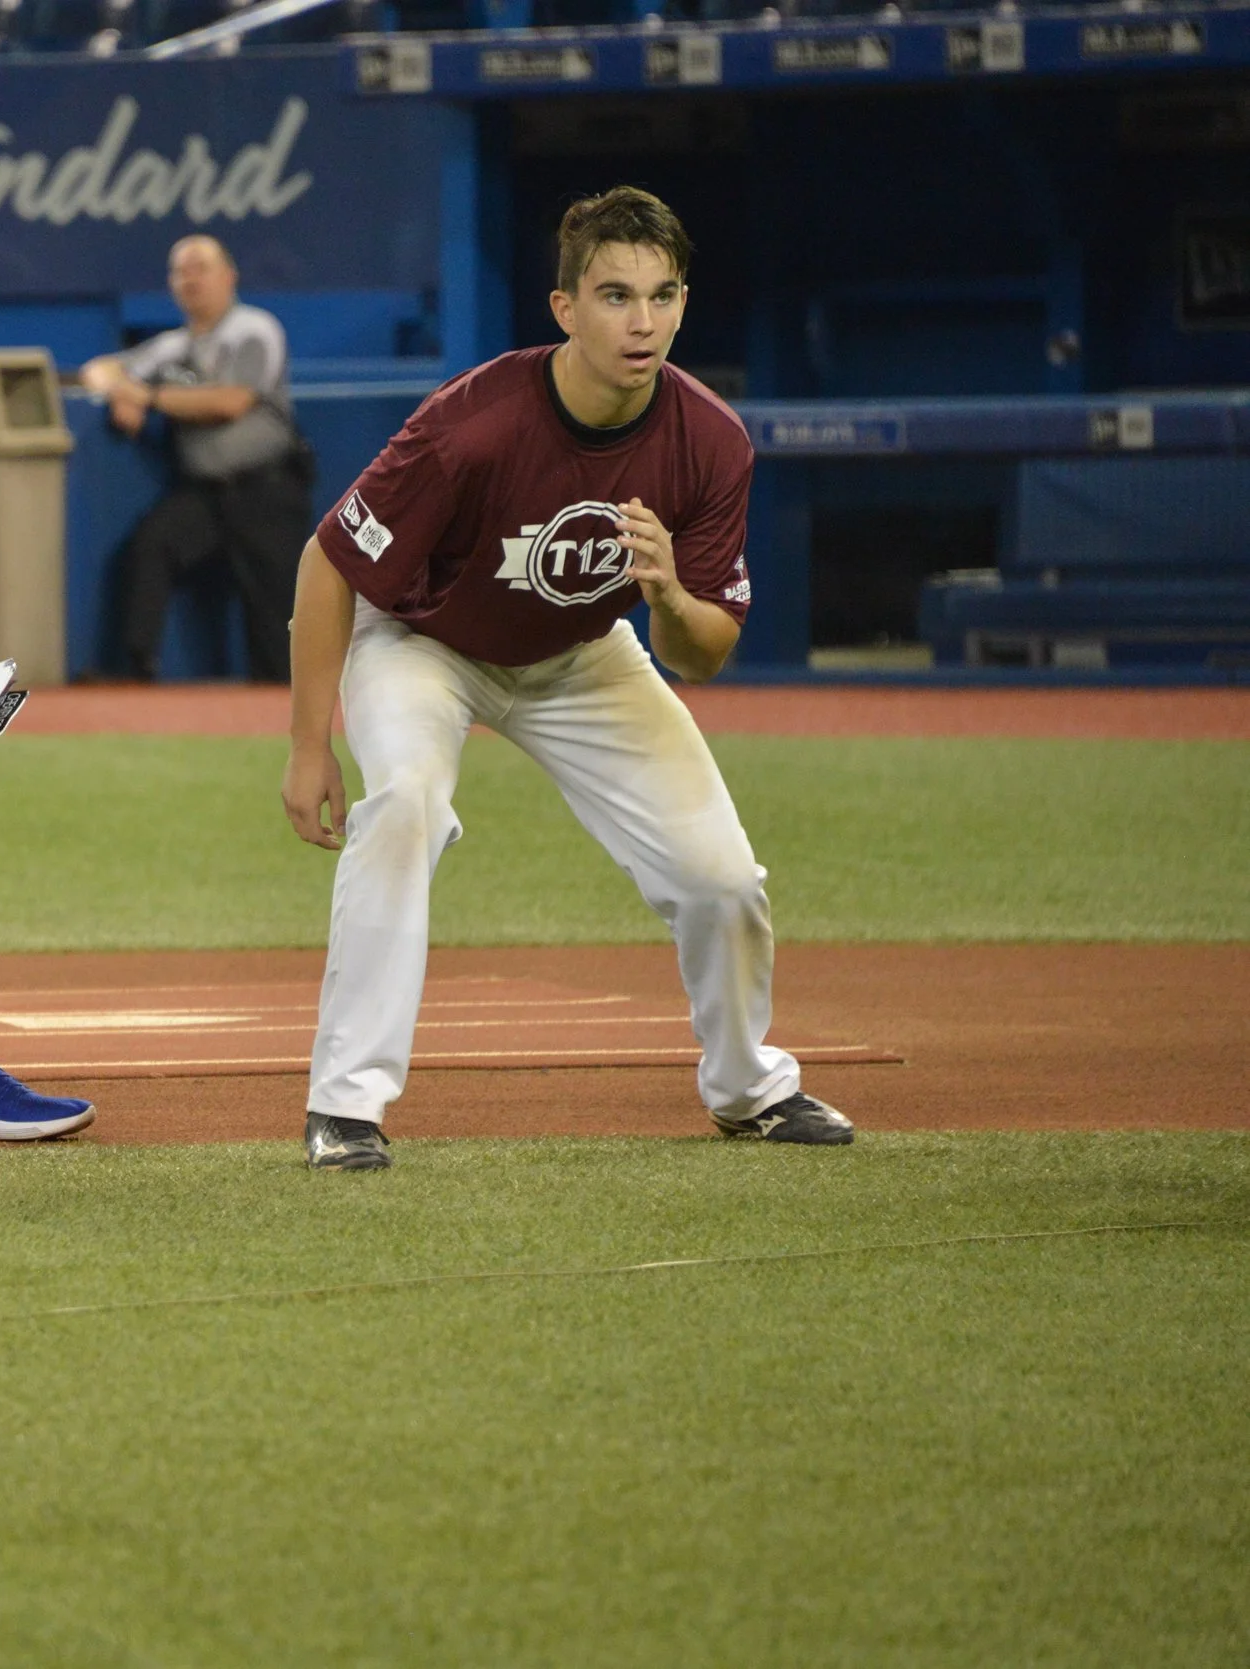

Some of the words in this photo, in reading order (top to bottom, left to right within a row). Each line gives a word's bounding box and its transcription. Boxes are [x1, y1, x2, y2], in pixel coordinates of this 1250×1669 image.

[361, 531, 382, 552] ERA
[365, 524, 387, 545] NEW
[547, 537, 622, 577] T12
